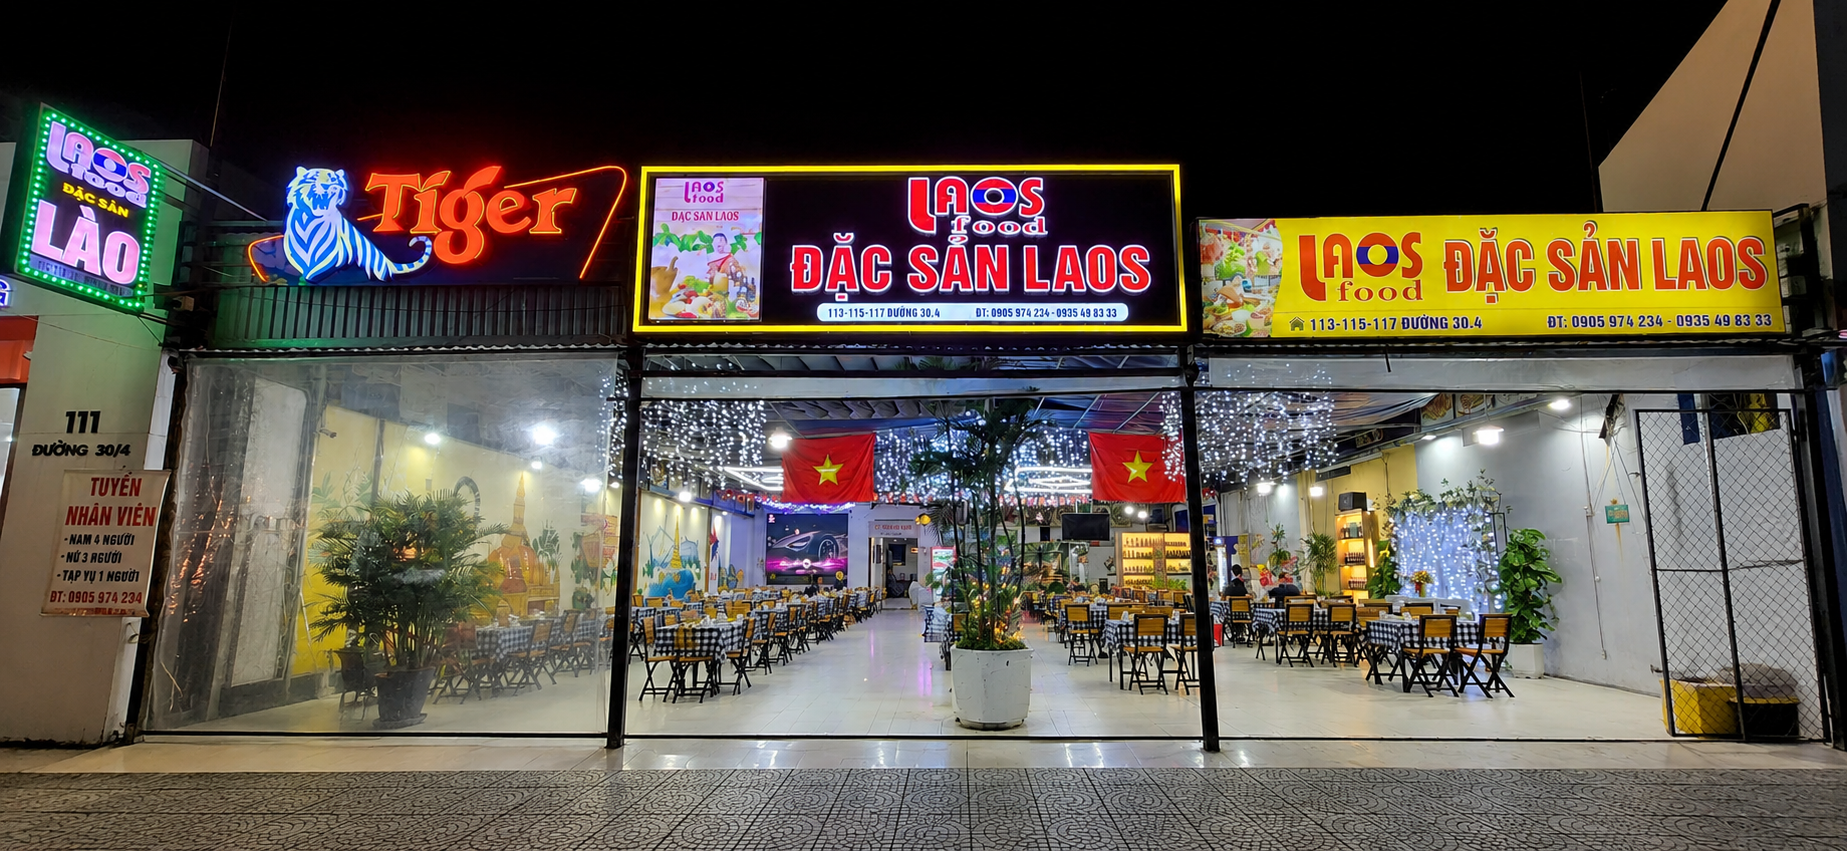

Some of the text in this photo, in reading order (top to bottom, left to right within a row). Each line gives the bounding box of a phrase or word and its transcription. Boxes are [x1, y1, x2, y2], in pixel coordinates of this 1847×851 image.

[46, 120, 151, 195] LAOS
[70, 164, 148, 209] food
[684, 181, 724, 203] LAOS
[692, 193, 724, 203] food
[907, 176, 1046, 235] LAOS
[364, 164, 577, 265] Tiger
[715, 211, 739, 221] LAOS
[951, 215, 1048, 237] food
[31, 199, 141, 285] LÀO
[789, 232, 1152, 302] ĐẶC SẢN LAOS
[1298, 231, 1424, 301] LAOS
[1443, 220, 1769, 305] ĐẶC SẢN LAOS
[1336, 280, 1424, 302] food
[828, 308, 885, 318] 113-115-117
[920, 308, 940, 318] 30.4
[975, 307, 989, 318] ĐT:
[991, 307, 1013, 318] 0905
[1015, 307, 1032, 318] 974
[1033, 307, 1050, 318] 234
[1056, 307, 1079, 318] 0935
[1080, 307, 1092, 318] 49
[1093, 307, 1104, 318] 83
[1106, 307, 1118, 318] 33
[1310, 314, 1483, 331] 113-115-117 ĐƯỜNG 30.4
[1547, 315, 1567, 328] ĐT:
[1571, 315, 1604, 328] 0905
[1609, 314, 1634, 328] 974
[1638, 314, 1663, 328] 234
[1676, 314, 1710, 327] 0935
[1714, 314, 1730, 327] 49
[1735, 314, 1751, 327] 83
[1755, 313, 1772, 327] 33
[65, 410, 101, 434] 111
[32, 440, 131, 458] ĐƯỜNG 30/4
[65, 502, 157, 527] NHÂN VIÊN
[94, 534, 100, 545] 4
[82, 552, 88, 563] 3
[99, 570, 104, 581] 1
[68, 591, 95, 603] 0905
[98, 591, 118, 604] 974
[121, 592, 142, 604] 234
